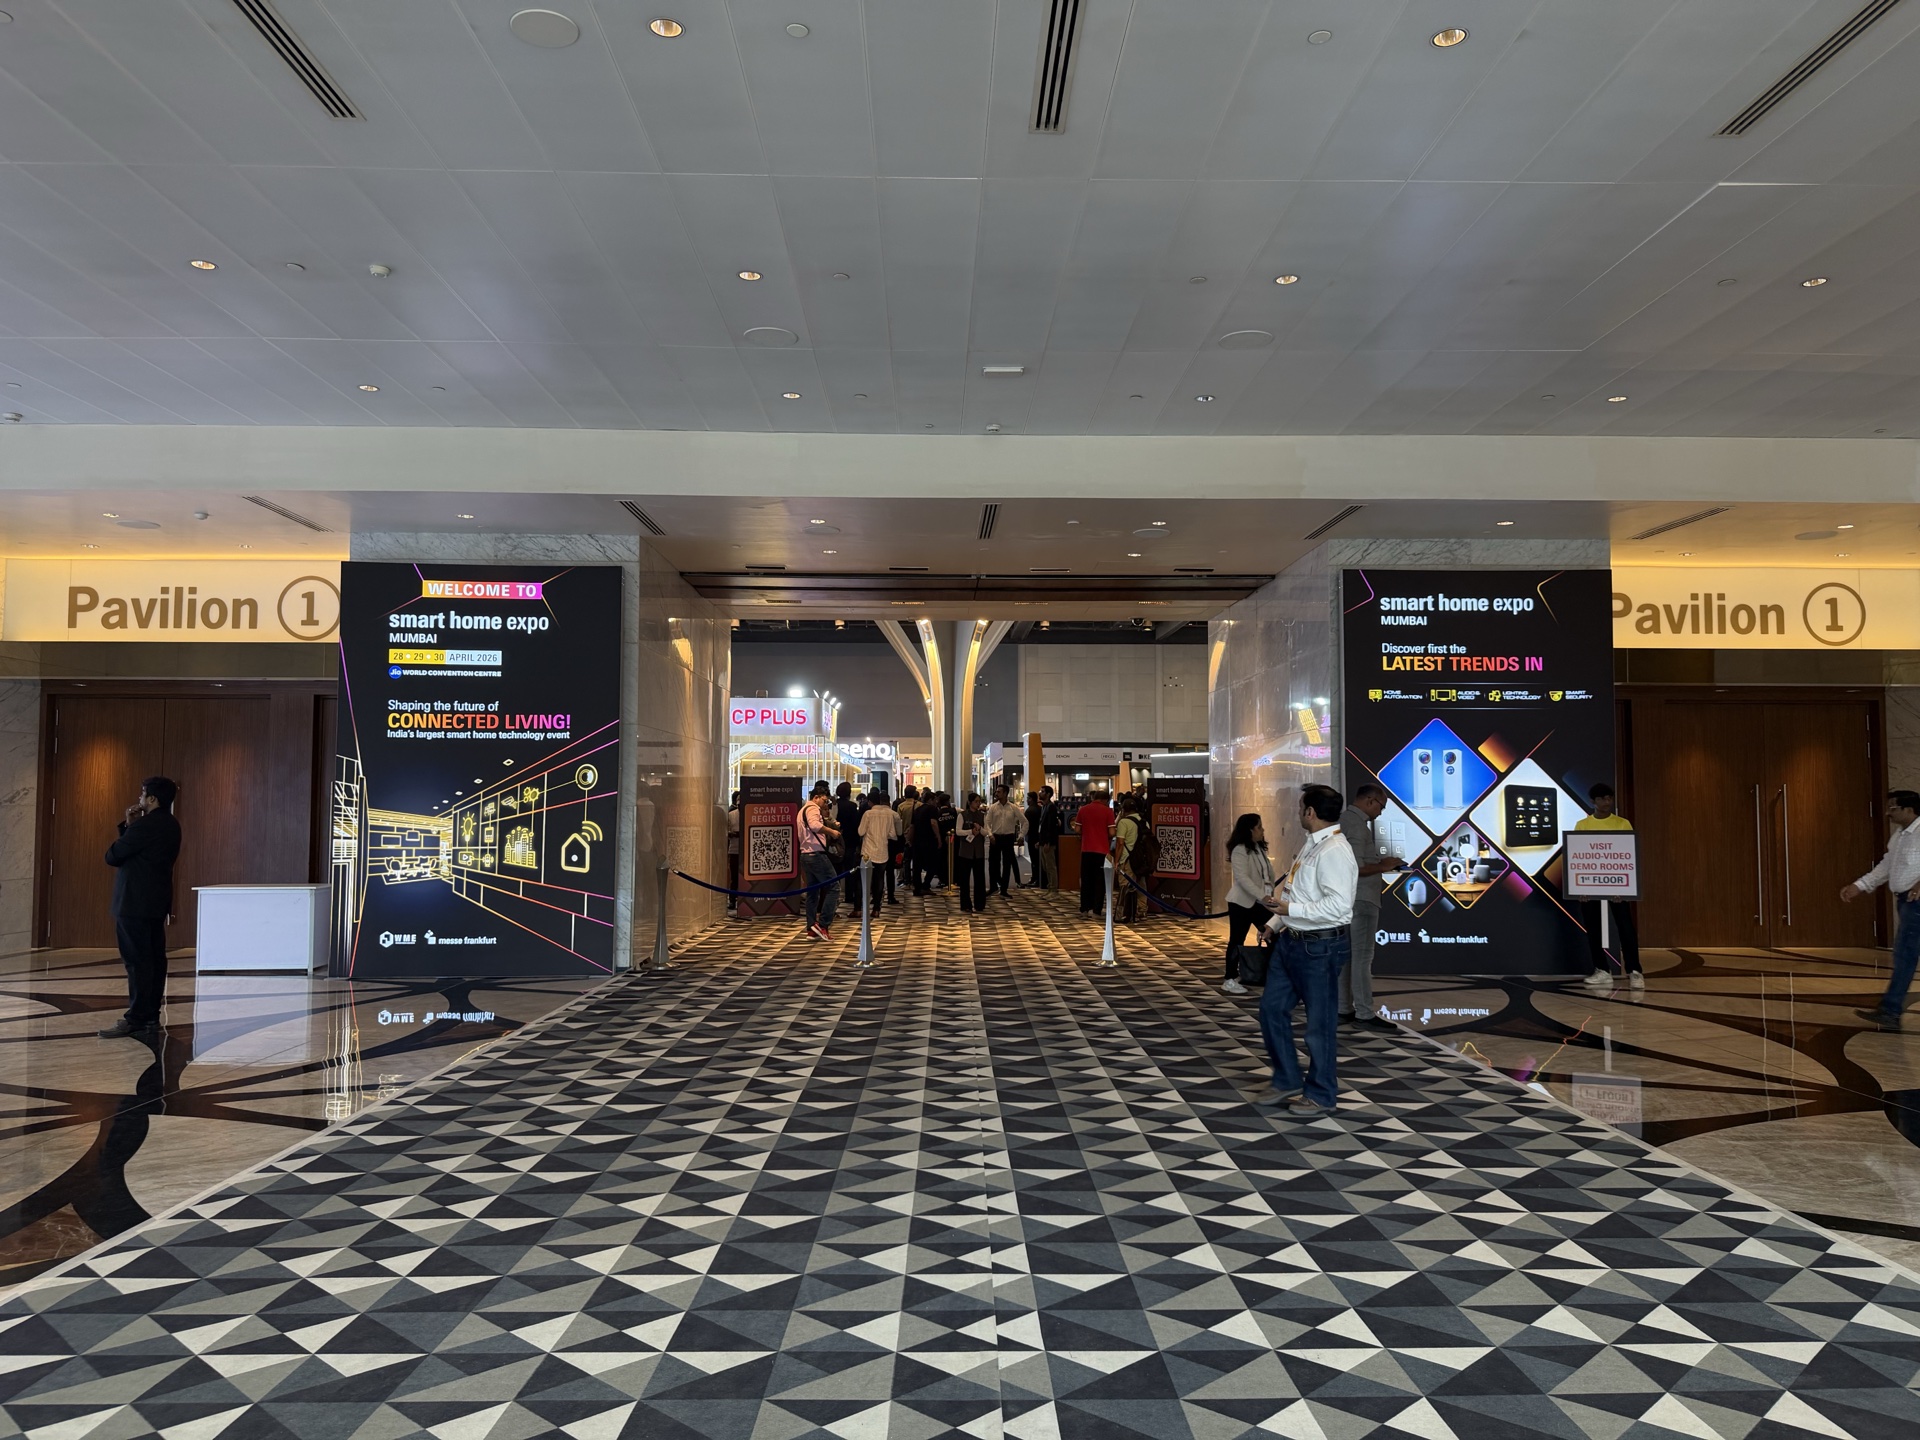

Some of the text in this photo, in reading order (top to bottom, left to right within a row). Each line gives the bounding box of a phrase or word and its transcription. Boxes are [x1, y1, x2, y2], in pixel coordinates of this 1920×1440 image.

[428, 582, 537, 598] WELCOME TO
[67, 586, 258, 630] Pavilion
[1380, 594, 1534, 615] smart home expo
[1612, 592, 1785, 635] Pavilion
[389, 611, 549, 634] smart home expo
[1381, 616, 1427, 626] MUMBAI
[389, 633, 437, 644] MUMBAI
[1382, 643, 1467, 654] Discover first the
[393, 653, 498, 662] 28 29 30 APRIL 2026
[1382, 656, 1543, 671] LATEST TRENDS IN
[390, 668, 402, 676] Jio
[388, 699, 500, 713] Shaping the future of
[387, 713, 571, 729] CONNECTED LIVING!
[732, 709, 756, 725] CP
[760, 709, 807, 725] PLUS
[387, 729, 570, 741] India's largest smart home technology event
[775, 744, 789, 754] CP
[753, 806, 790, 815] SCAN TO
[1159, 806, 1180, 814] SCAN
[751, 815, 792, 823] REGISTER
[1157, 815, 1194, 823] REGISTER
[1571, 852, 1631, 860] AUDIO-VIDEO
[1600, 863, 1634, 871] ROOMS
[1580, 876, 1624, 884] 1st FLOOR
[394, 934, 417, 943] WME
[438, 936, 497, 945] messe frankfurt
[1389, 932, 1412, 941] WME
[1432, 935, 1488, 944] messe frankfurt
